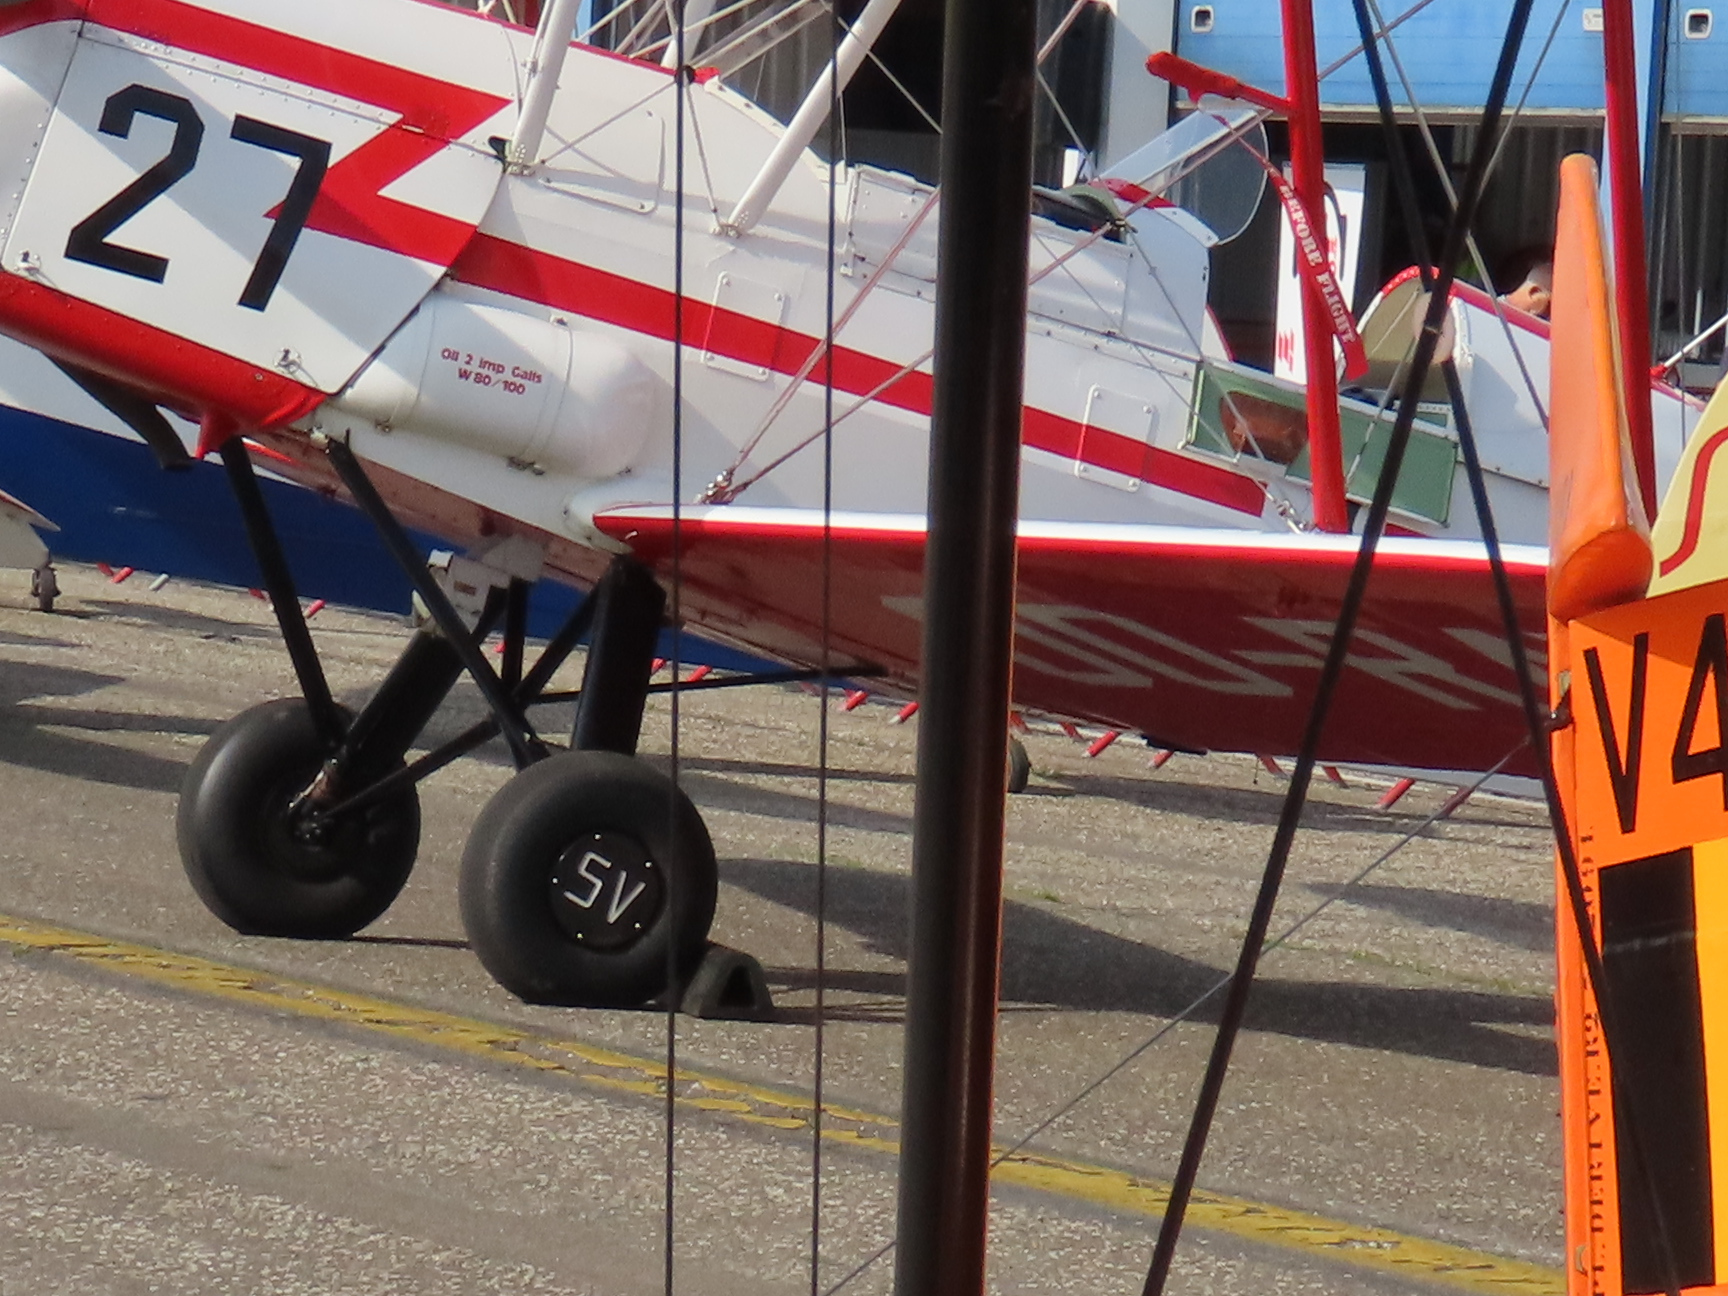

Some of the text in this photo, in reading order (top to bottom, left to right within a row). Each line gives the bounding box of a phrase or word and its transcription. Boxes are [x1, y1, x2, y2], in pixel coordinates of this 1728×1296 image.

[64, 84, 332, 312] 27
[1280, 185, 1356, 343] BEFORE FLIGHT
[441, 348, 460, 362] Oil
[464, 354, 474, 365] 2
[563, 851, 647, 924] SV
